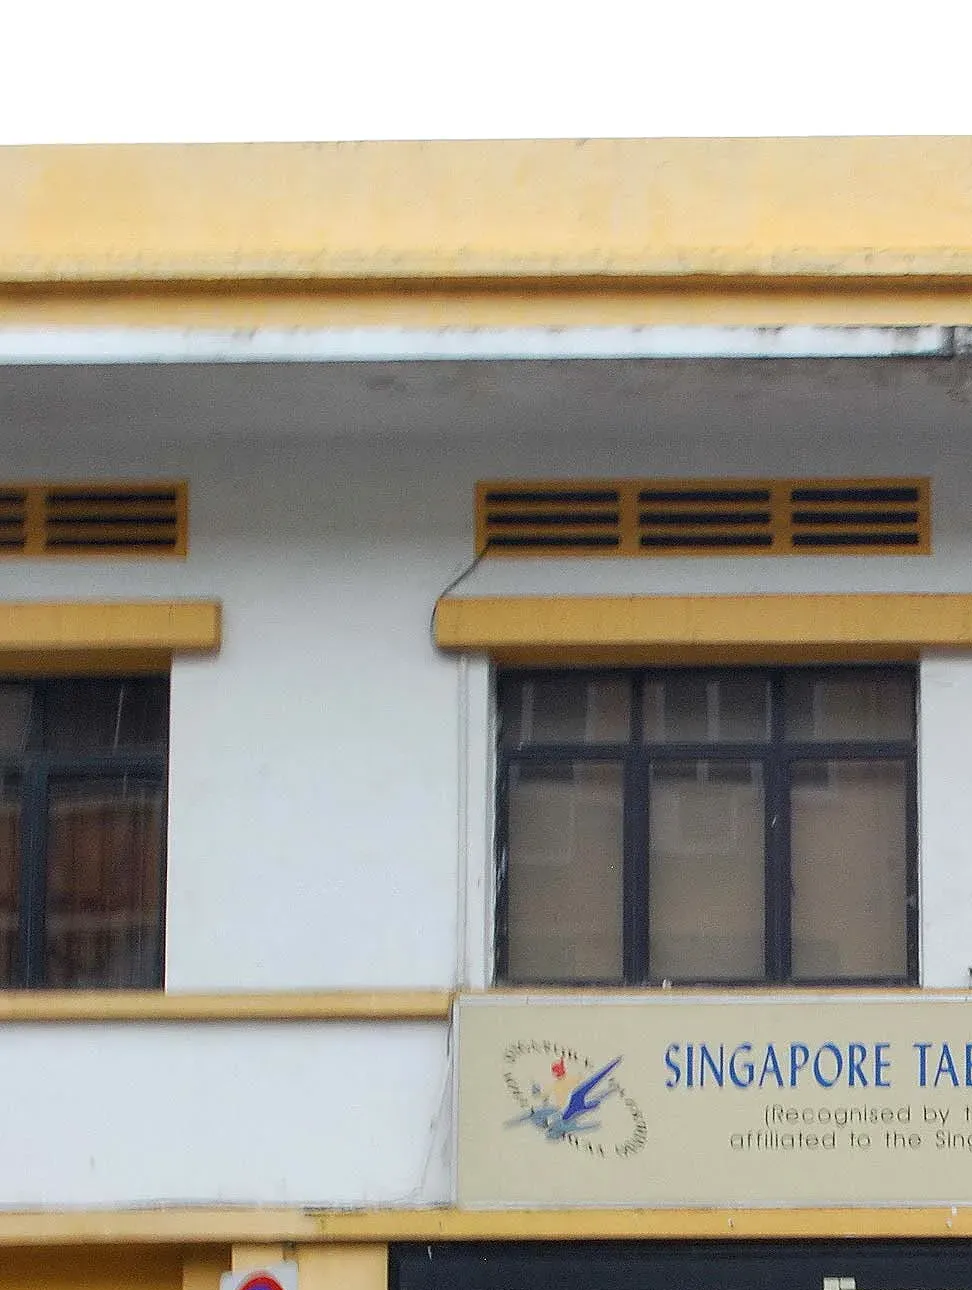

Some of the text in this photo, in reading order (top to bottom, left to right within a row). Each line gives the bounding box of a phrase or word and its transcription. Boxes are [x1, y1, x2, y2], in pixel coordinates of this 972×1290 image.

[664, 1042, 891, 1089] SINGAPORE
[764, 1104, 912, 1127] (Recognised
[922, 1105, 951, 1128] by
[730, 1131, 836, 1151] affiliated
[848, 1133, 872, 1151] to
[885, 1131, 923, 1150] the
